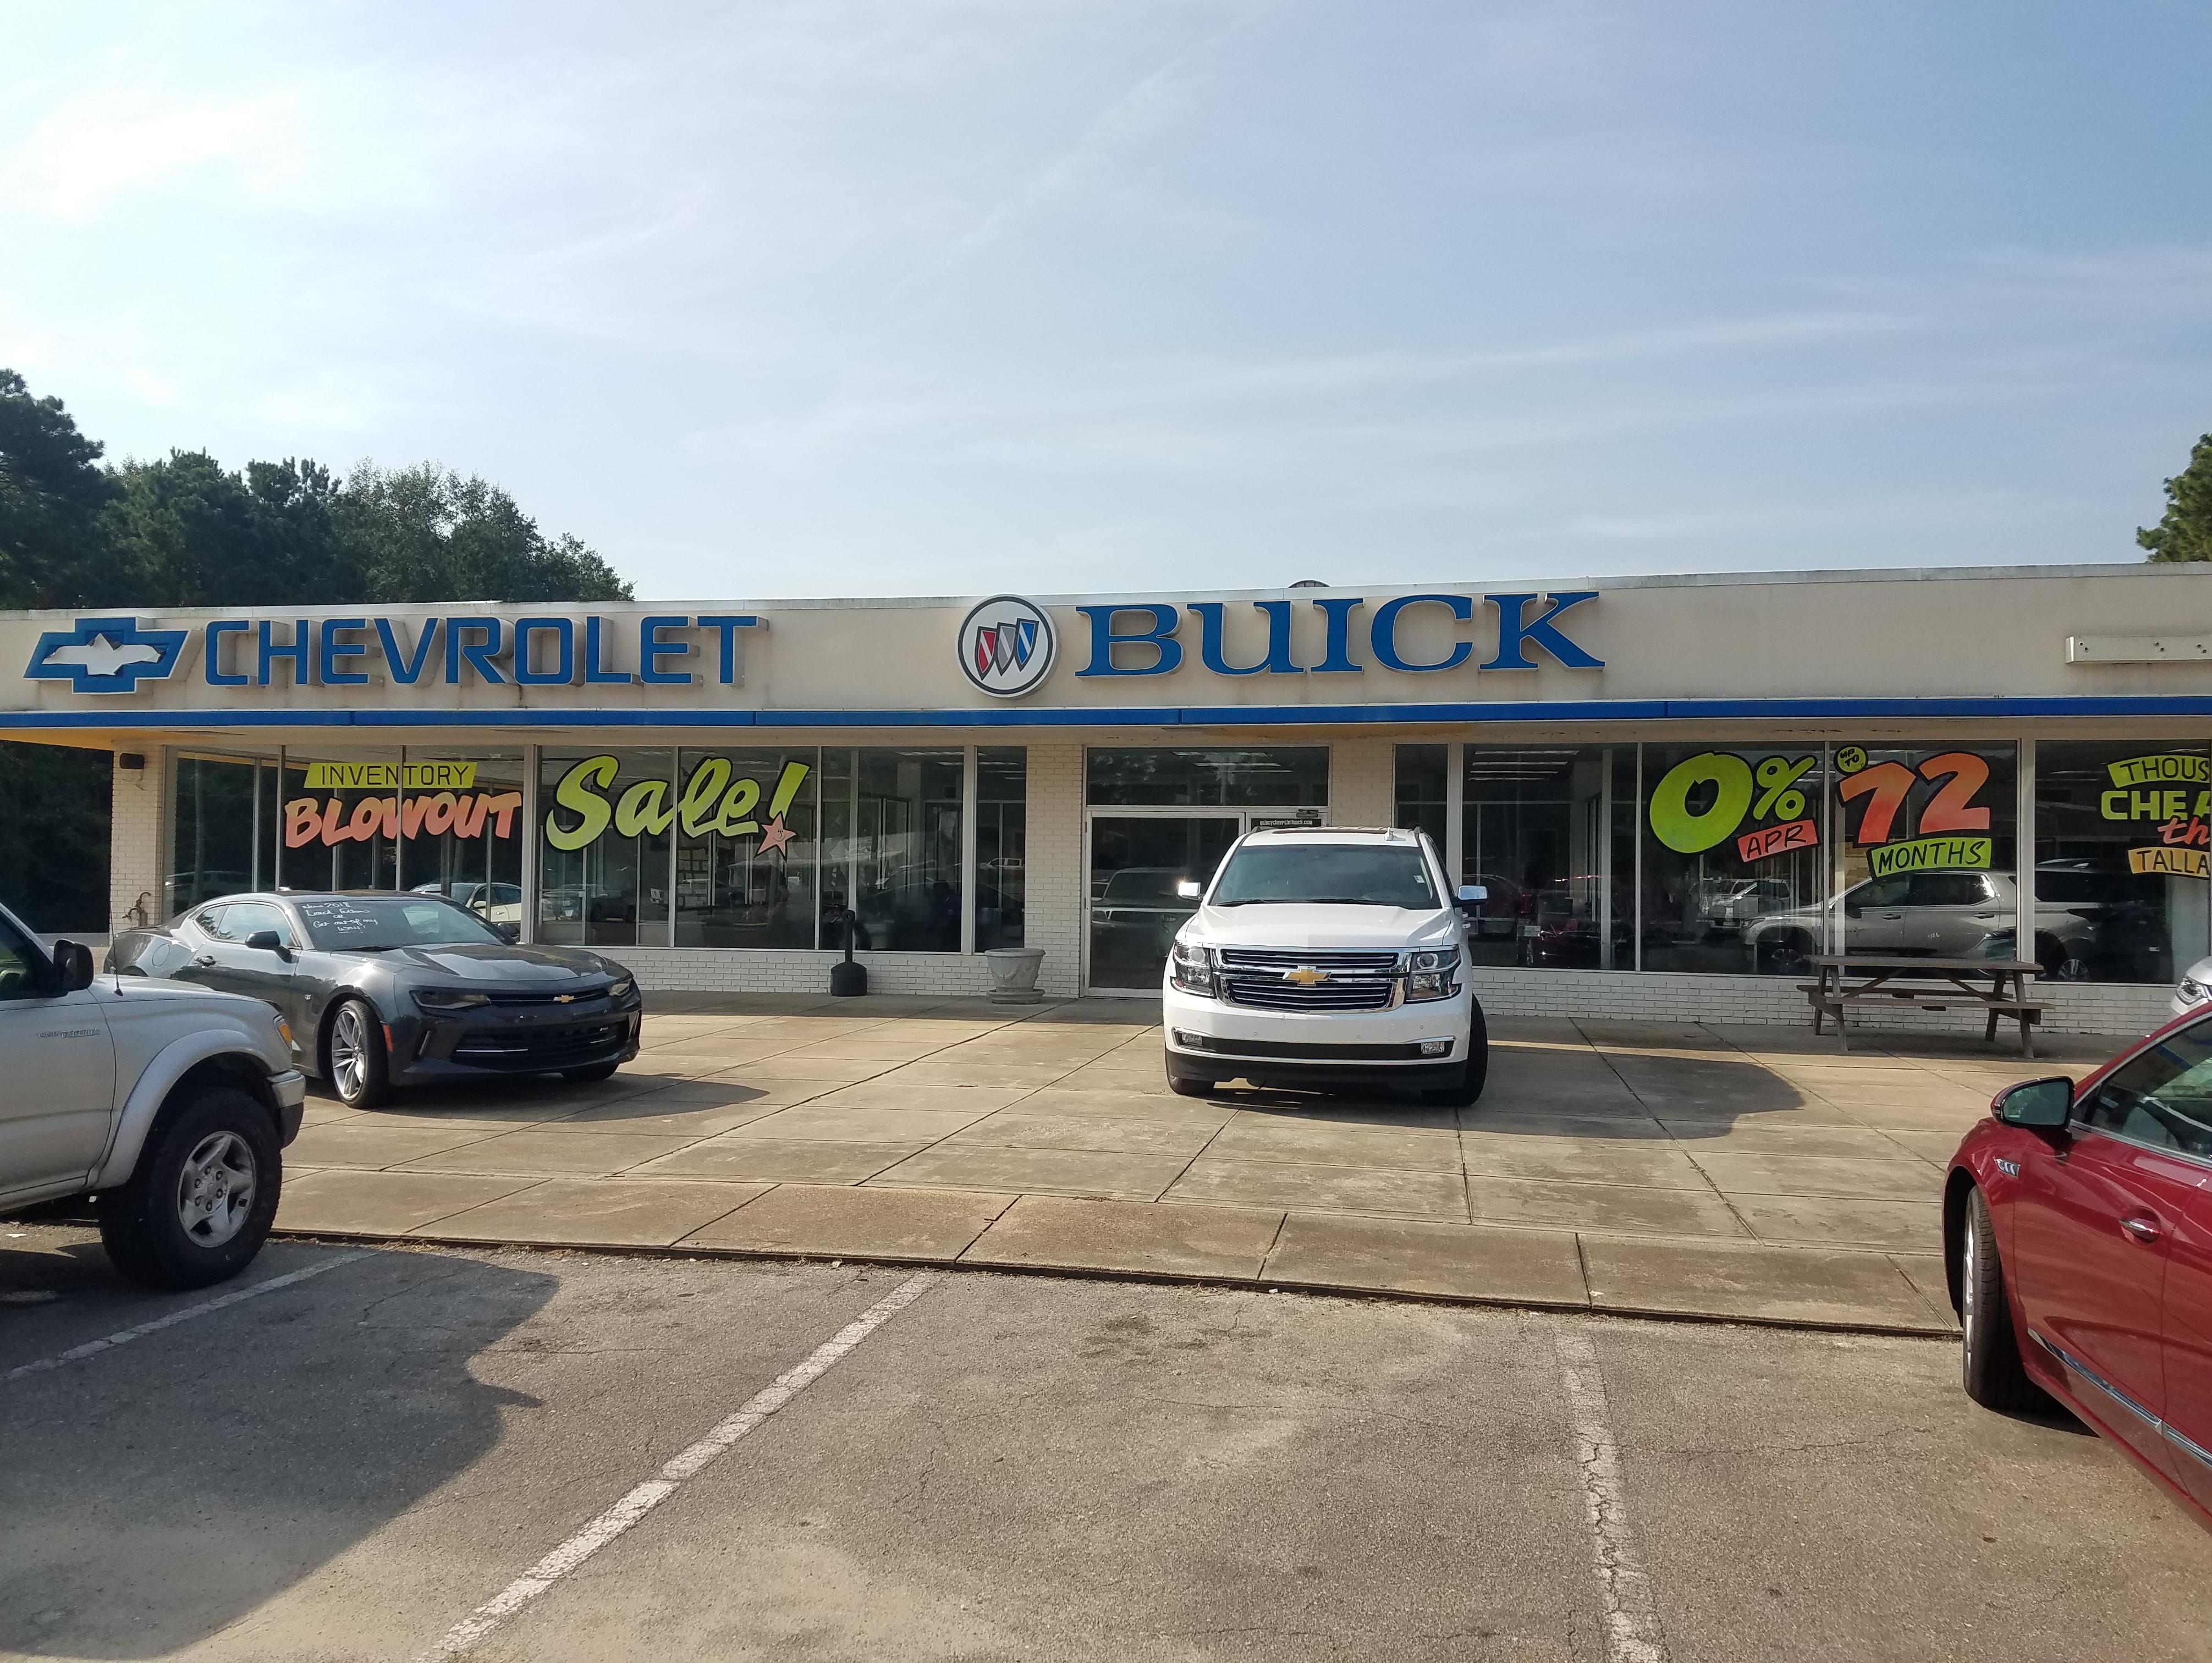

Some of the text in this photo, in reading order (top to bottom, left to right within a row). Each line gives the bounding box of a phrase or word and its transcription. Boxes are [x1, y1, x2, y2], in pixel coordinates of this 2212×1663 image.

[205, 615, 757, 686] CHEVROLET
[1075, 591, 1605, 677] BUICK
[321, 765, 470, 786] INVENTORY
[1844, 754, 1859, 767] TO
[2120, 757, 2209, 781] THOUS
[284, 791, 522, 849] BLOWOUT
[546, 754, 811, 851] Sale!
[1649, 752, 1815, 853] 0%
[1839, 752, 1990, 844] 72
[1746, 824, 1807, 860] APR
[1878, 841, 1985, 874] MONTHS
[2136, 850, 2209, 875] TALLA
